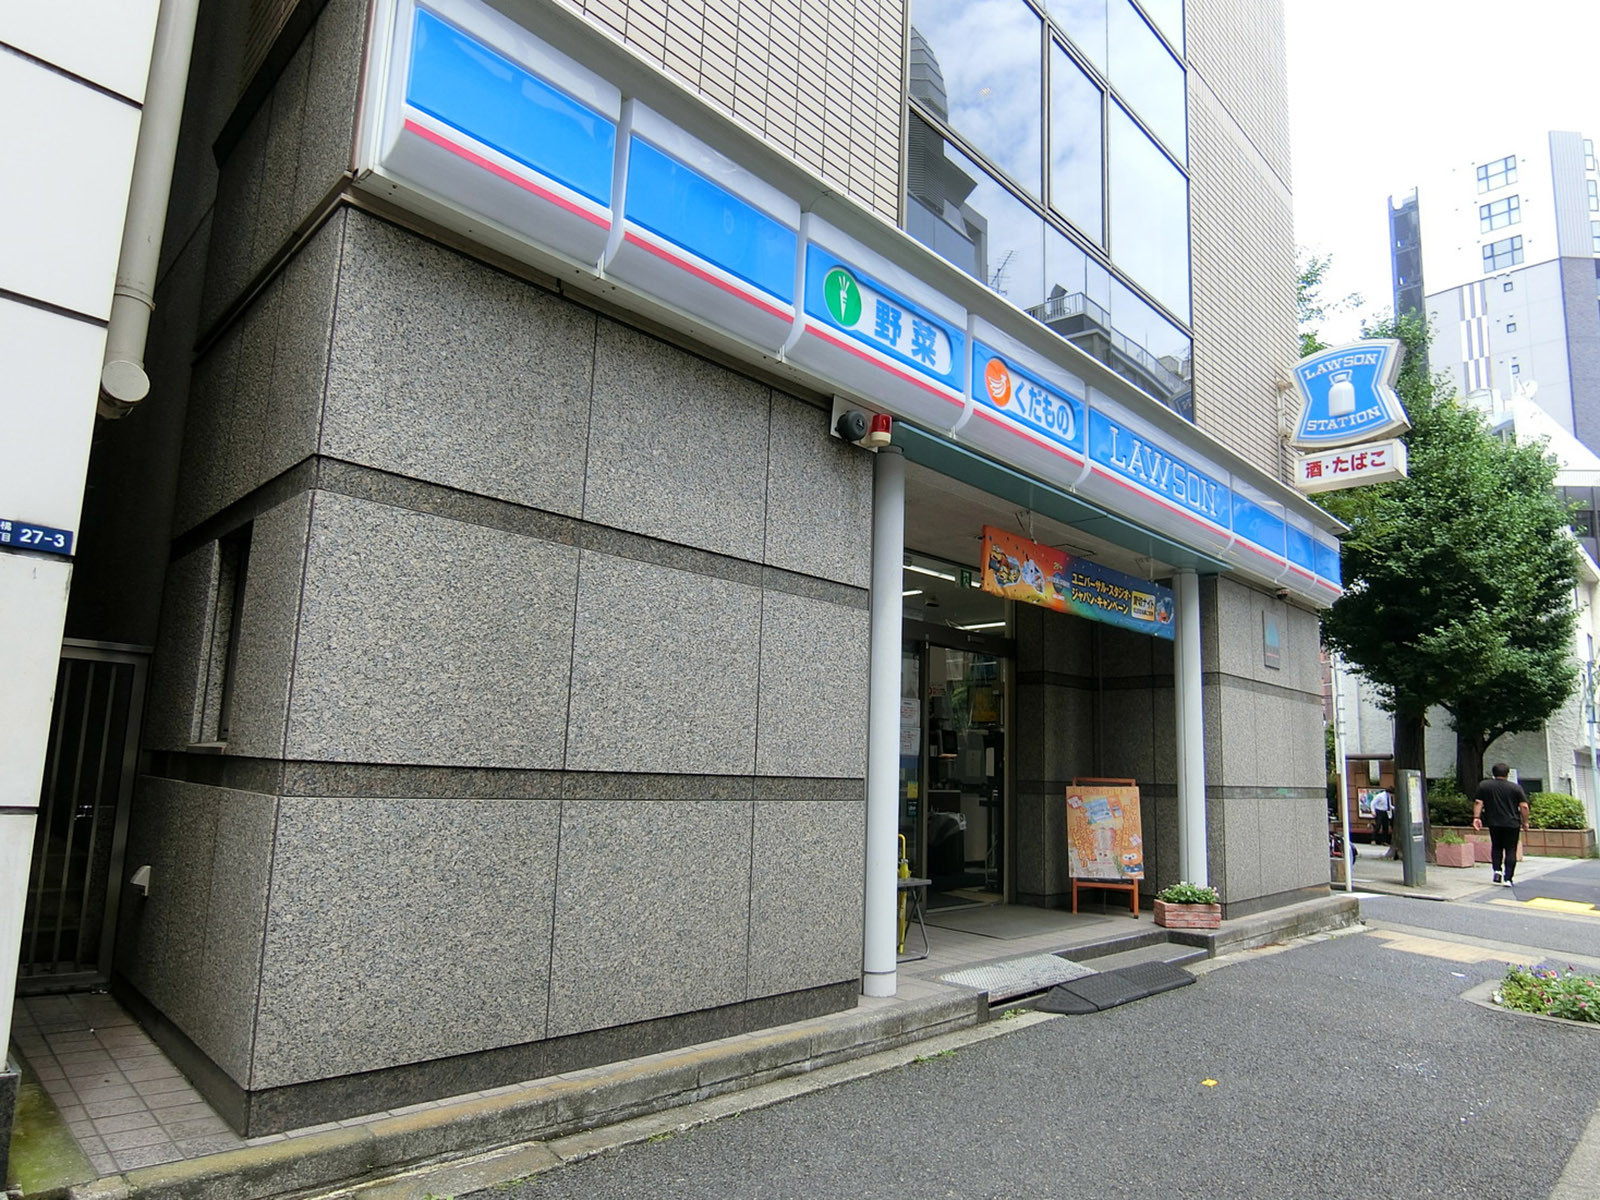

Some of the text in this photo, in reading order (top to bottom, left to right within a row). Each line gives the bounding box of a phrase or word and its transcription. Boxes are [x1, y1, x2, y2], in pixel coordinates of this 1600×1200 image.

[874, 299, 937, 366] 野菜
[1304, 353, 1379, 380] LAWSON
[1014, 382, 1070, 436] くだもの
[1306, 406, 1382, 432] STATION
[1109, 426, 1218, 517] LAWSON
[20, 528, 65, 547] 27-3
